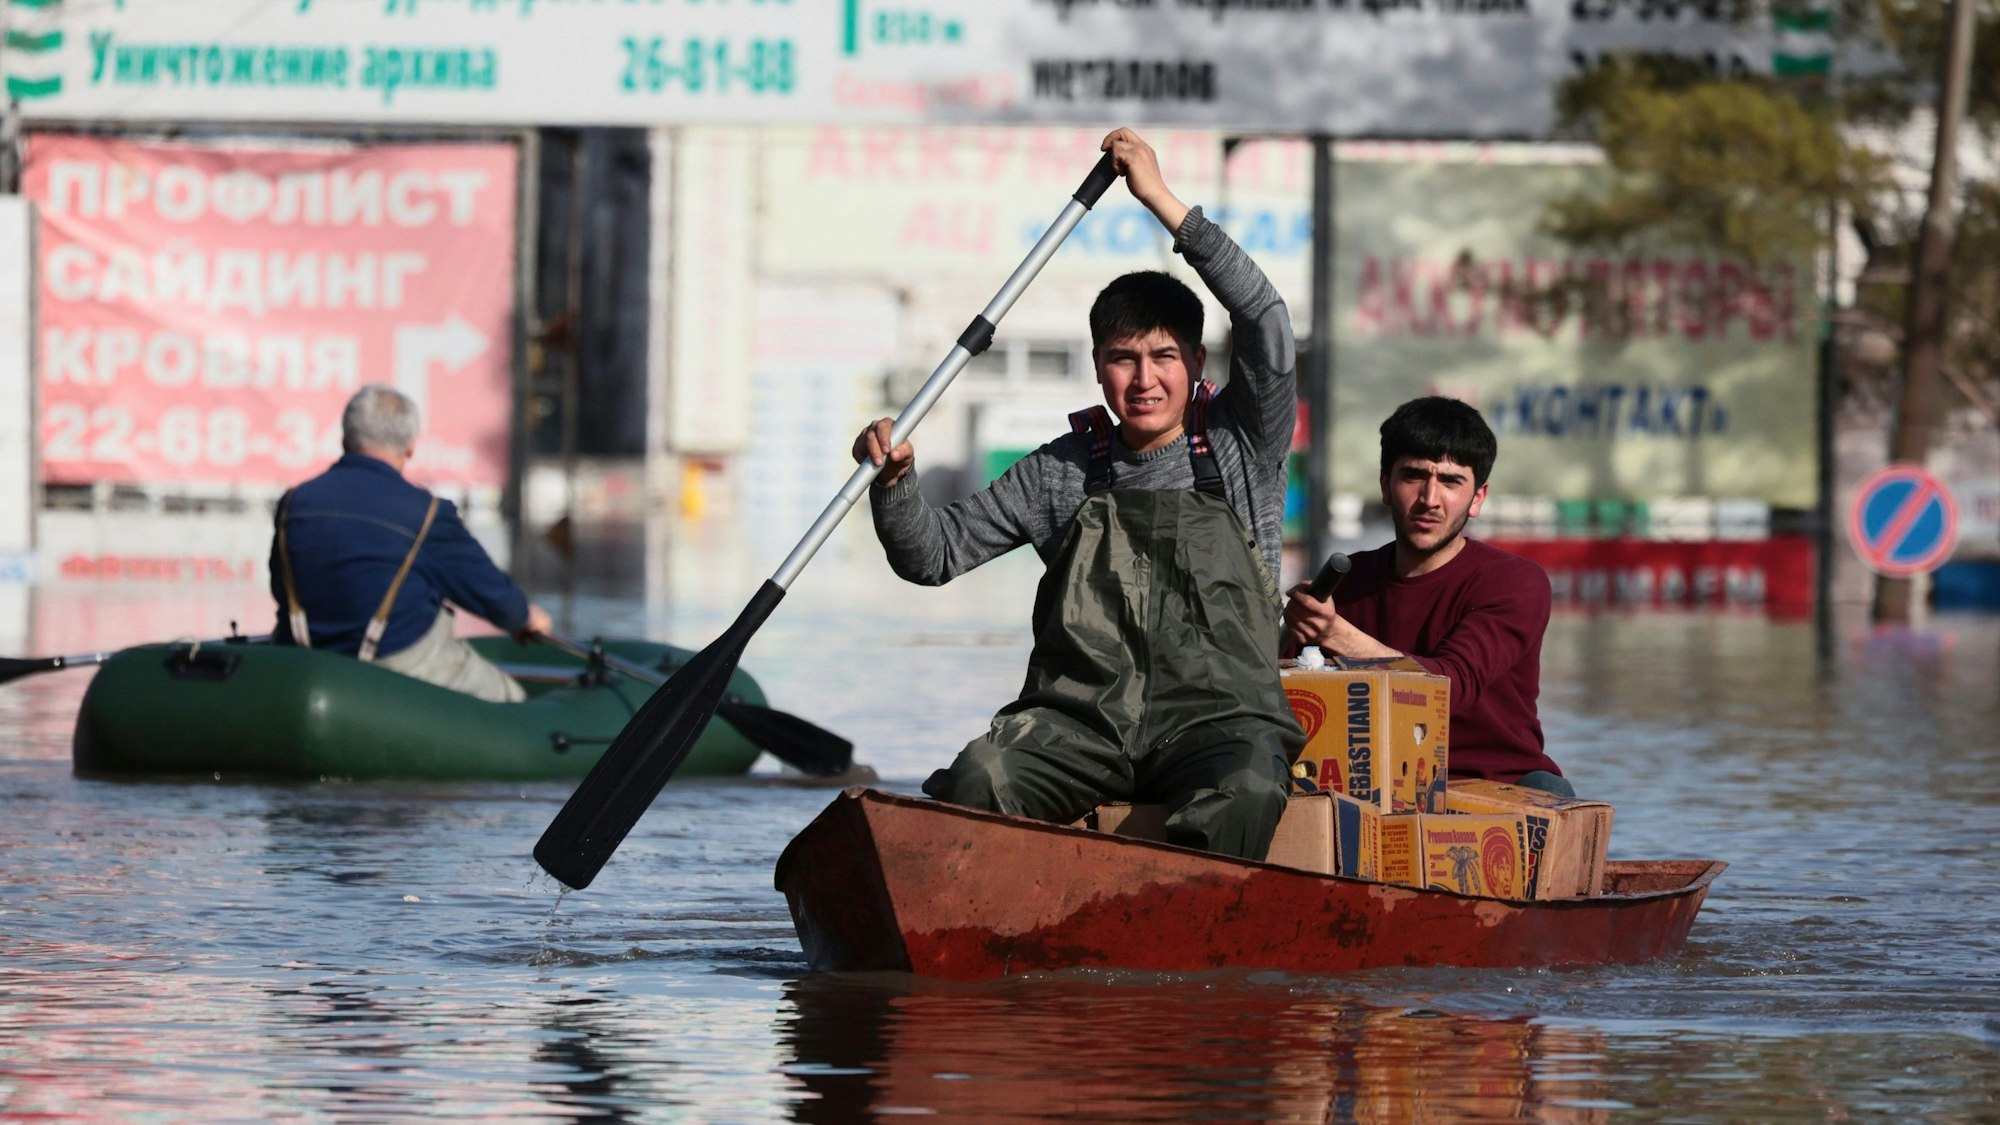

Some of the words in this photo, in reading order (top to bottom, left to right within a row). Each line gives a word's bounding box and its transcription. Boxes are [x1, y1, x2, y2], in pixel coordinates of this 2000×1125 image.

[90, 32, 348, 87] Уничтожение
[361, 44, 495, 104] архива
[620, 37, 796, 93] 26-81-88
[48, 160, 487, 226] ПРОФЛИСТ
[46, 238, 427, 313] САЙДИНГ
[44, 328, 358, 392] КРОВЛЯ
[1427, 829, 1452, 844] Premium
